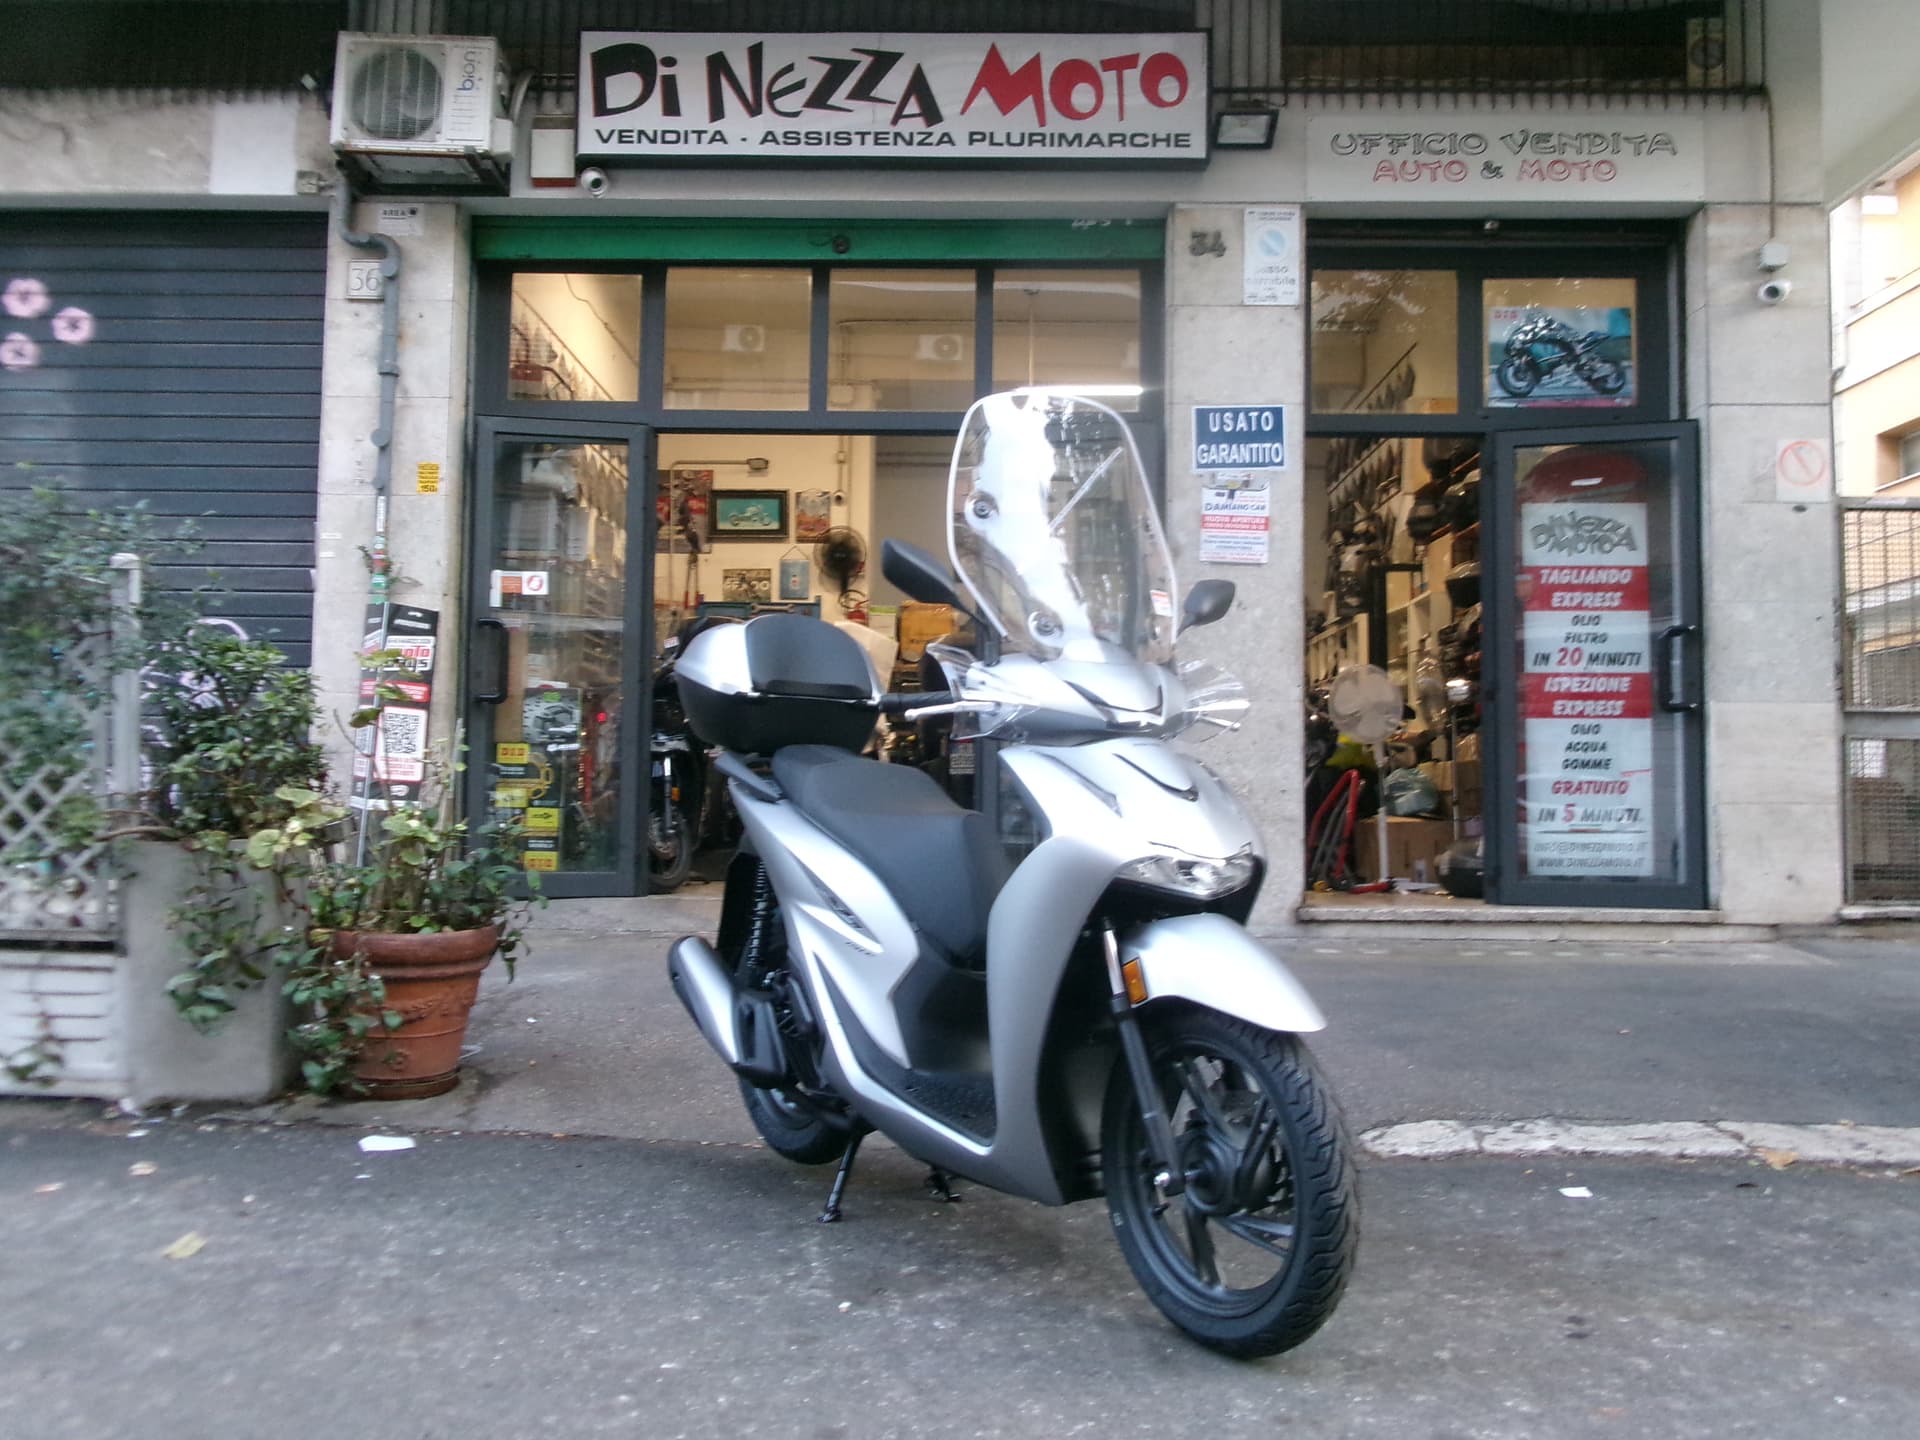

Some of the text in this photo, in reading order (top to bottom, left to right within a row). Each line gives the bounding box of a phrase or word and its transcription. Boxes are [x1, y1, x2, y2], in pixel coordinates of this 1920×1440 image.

[960, 41, 1189, 128] MOTO
[594, 128, 729, 145] VENDITA
[758, 130, 957, 147] ASSISTENZA
[967, 131, 1192, 148] PLURIMARCHE
[1330, 127, 1678, 157] UFFICIO VENDITA
[1372, 158, 1618, 183] AUTO & MOTO
[350, 267, 381, 292] 36
[1208, 410, 1275, 433] USATO
[1196, 442, 1283, 466] GARANTITO
[1539, 568, 1633, 586] TAGLIANDO
[1551, 591, 1624, 609] EXPRESS
[1570, 614, 1602, 627] OLIO
[1563, 631, 1609, 645] FILTRO
[1532, 646, 1643, 668] IN 20 MINUTI
[1543, 676, 1633, 693] ISPEZIONE
[1552, 699, 1626, 717] EXPRESS
[1570, 723, 1602, 736] OLIO
[1564, 740, 1609, 753] ACQUA
[1561, 757, 1614, 771] GOMME
[1551, 780, 1630, 796] GRATUITO
[1537, 807, 1557, 823] IN
[1561, 802, 1577, 824] 5
